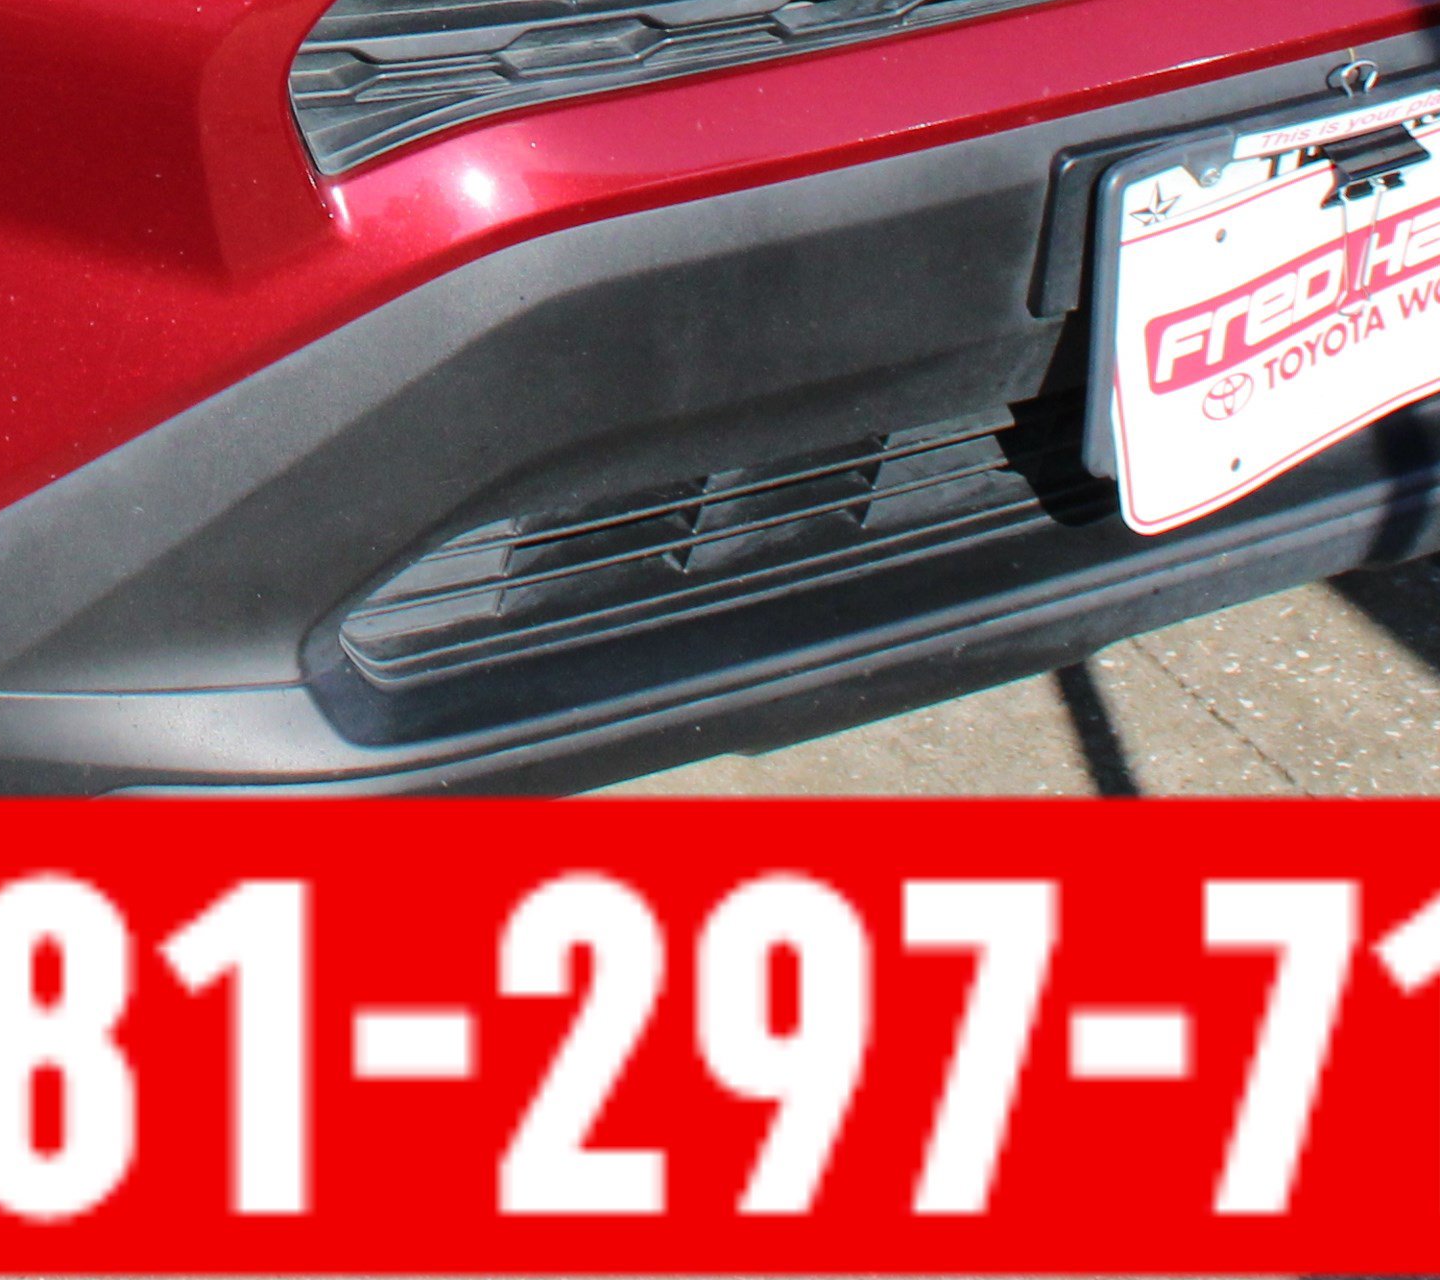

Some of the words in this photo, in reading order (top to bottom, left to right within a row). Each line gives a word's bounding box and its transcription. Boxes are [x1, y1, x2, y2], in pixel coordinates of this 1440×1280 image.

[1261, 127, 1311, 149] This
[1318, 120, 1340, 135] is
[1345, 108, 1398, 135] your
[1262, 305, 1387, 390] TOYOTA
